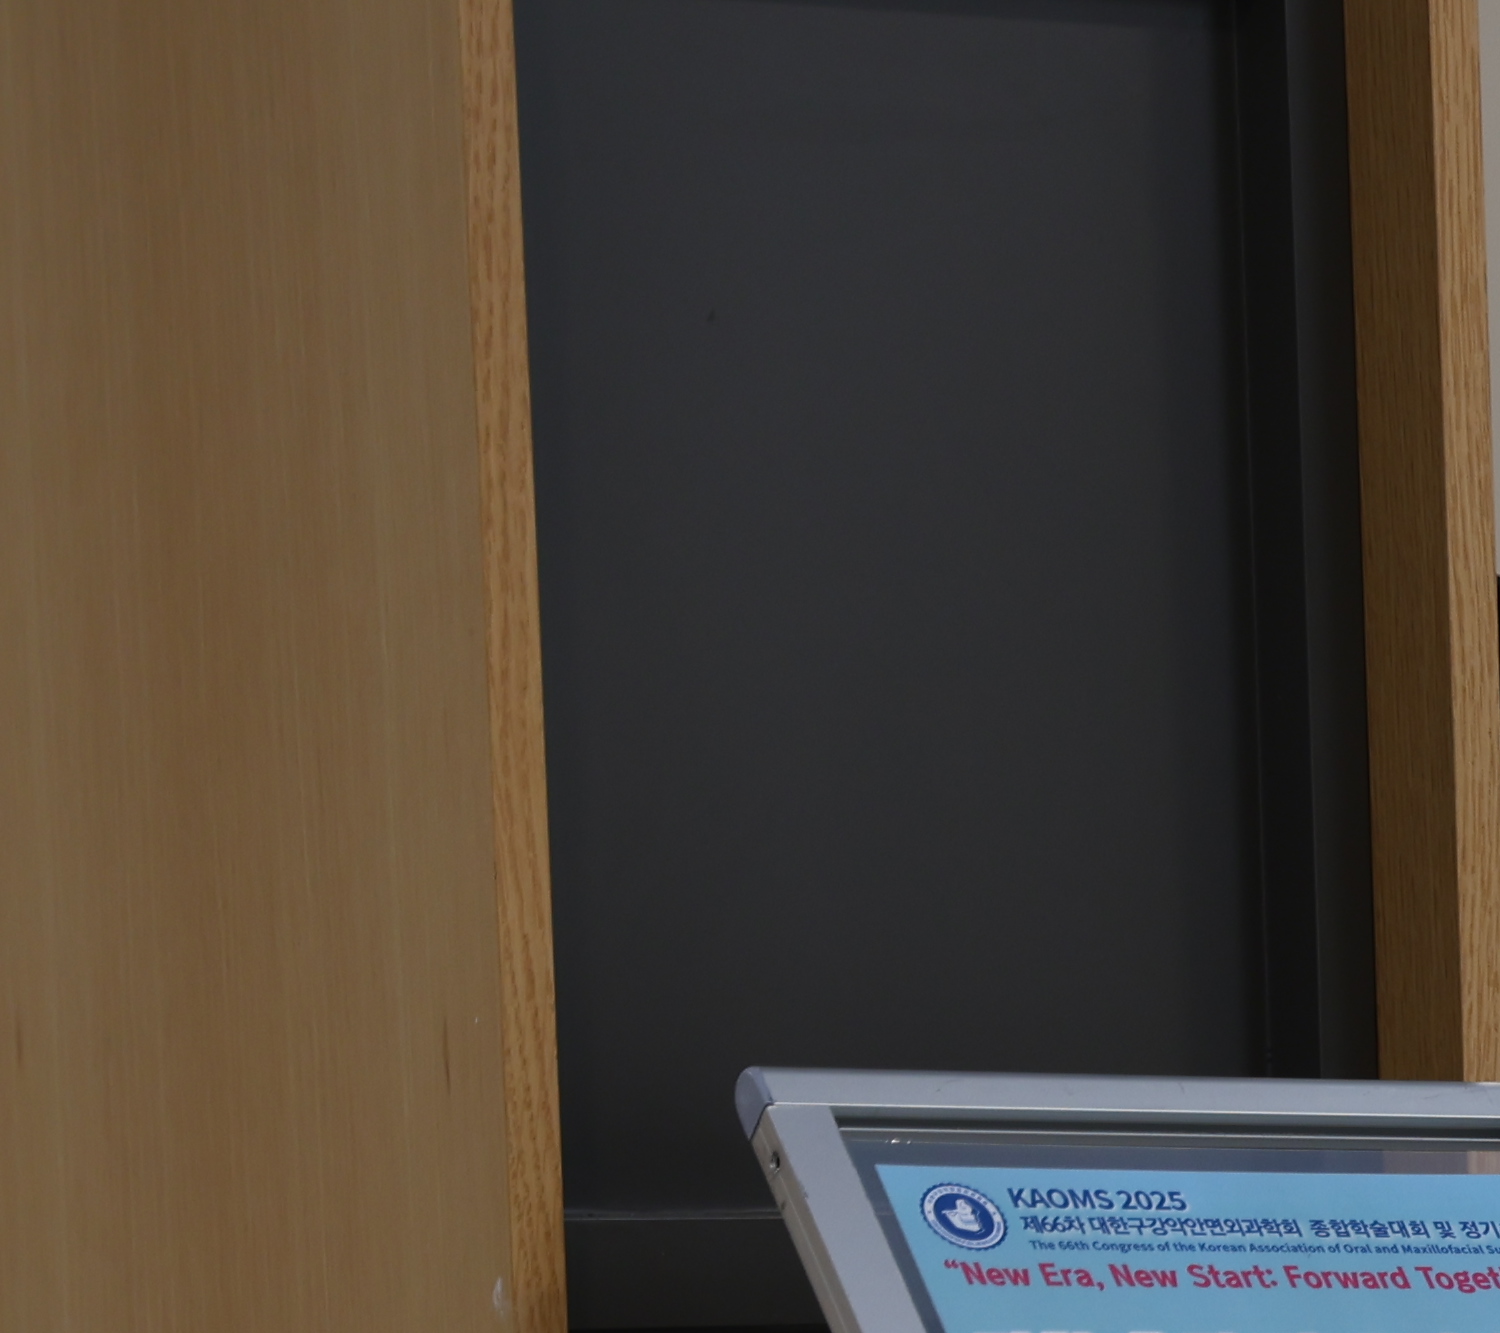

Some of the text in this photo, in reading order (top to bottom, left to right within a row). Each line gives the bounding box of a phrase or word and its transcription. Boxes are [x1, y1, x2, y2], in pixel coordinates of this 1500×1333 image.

[1007, 1188, 1187, 1211] KAOMS 2025
[1020, 1215, 1086, 1235] 제66차
[1089, 1216, 1302, 1237] 대한구강악안면외과학회
[1309, 1219, 1430, 1239] 종합학술대회
[1434, 1220, 1456, 1239] 및
[1029, 1240, 1055, 1250] The
[1058, 1240, 1090, 1250] 66th
[1093, 1240, 1153, 1254] Congress
[1156, 1241, 1171, 1252] of
[1173, 1241, 1196, 1252] the
[1197, 1241, 1245, 1252] Korean
[1249, 1243, 1325, 1254] Association
[1328, 1243, 1341, 1254] of
[1343, 1244, 1372, 1254] Oral
[1375, 1244, 1399, 1254] and
[1401, 1244, 1484, 1255] Maxillofacial
[944, 1259, 1031, 1285] “New
[1038, 1263, 1105, 1290] Era,
[1107, 1264, 1178, 1287] New
[1186, 1264, 1277, 1288] Start:
[1282, 1265, 1411, 1289] Forward
